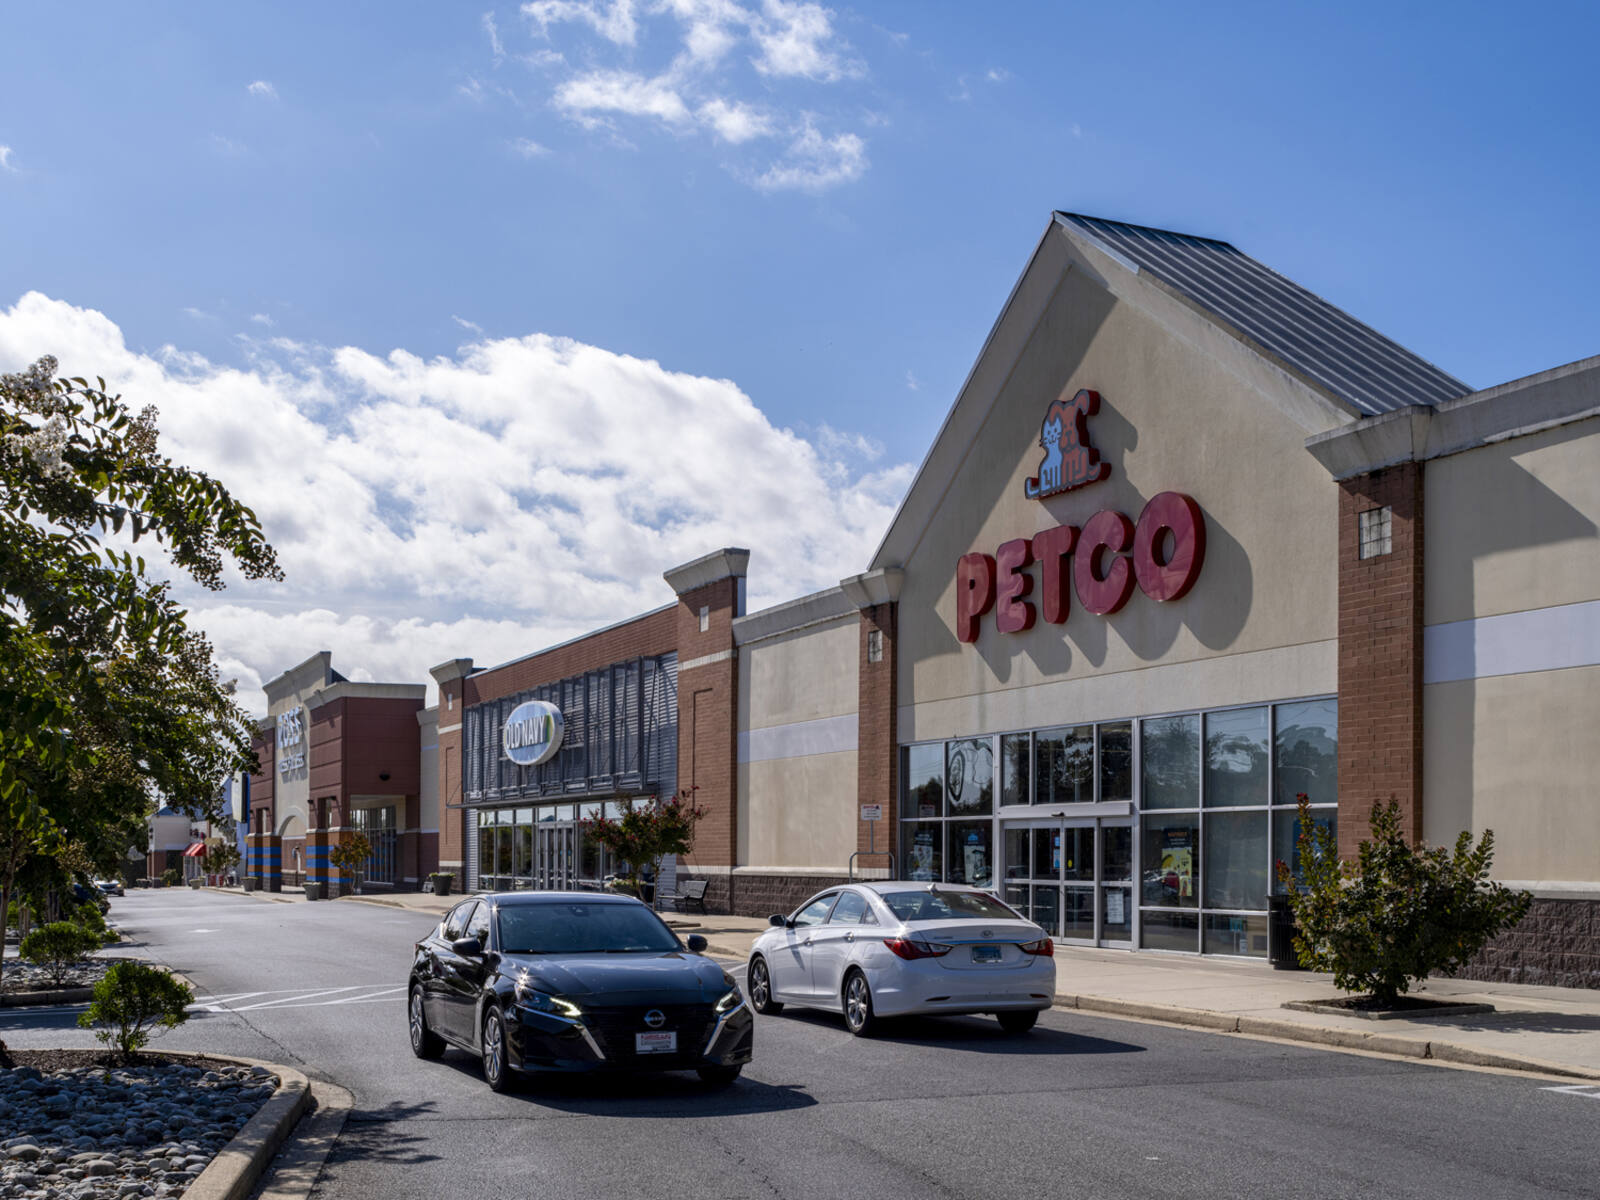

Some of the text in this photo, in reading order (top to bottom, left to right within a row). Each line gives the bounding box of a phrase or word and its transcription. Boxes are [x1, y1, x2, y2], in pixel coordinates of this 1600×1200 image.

[956, 491, 1207, 643] PETCO
[505, 715, 545, 750] OLD NAVY
